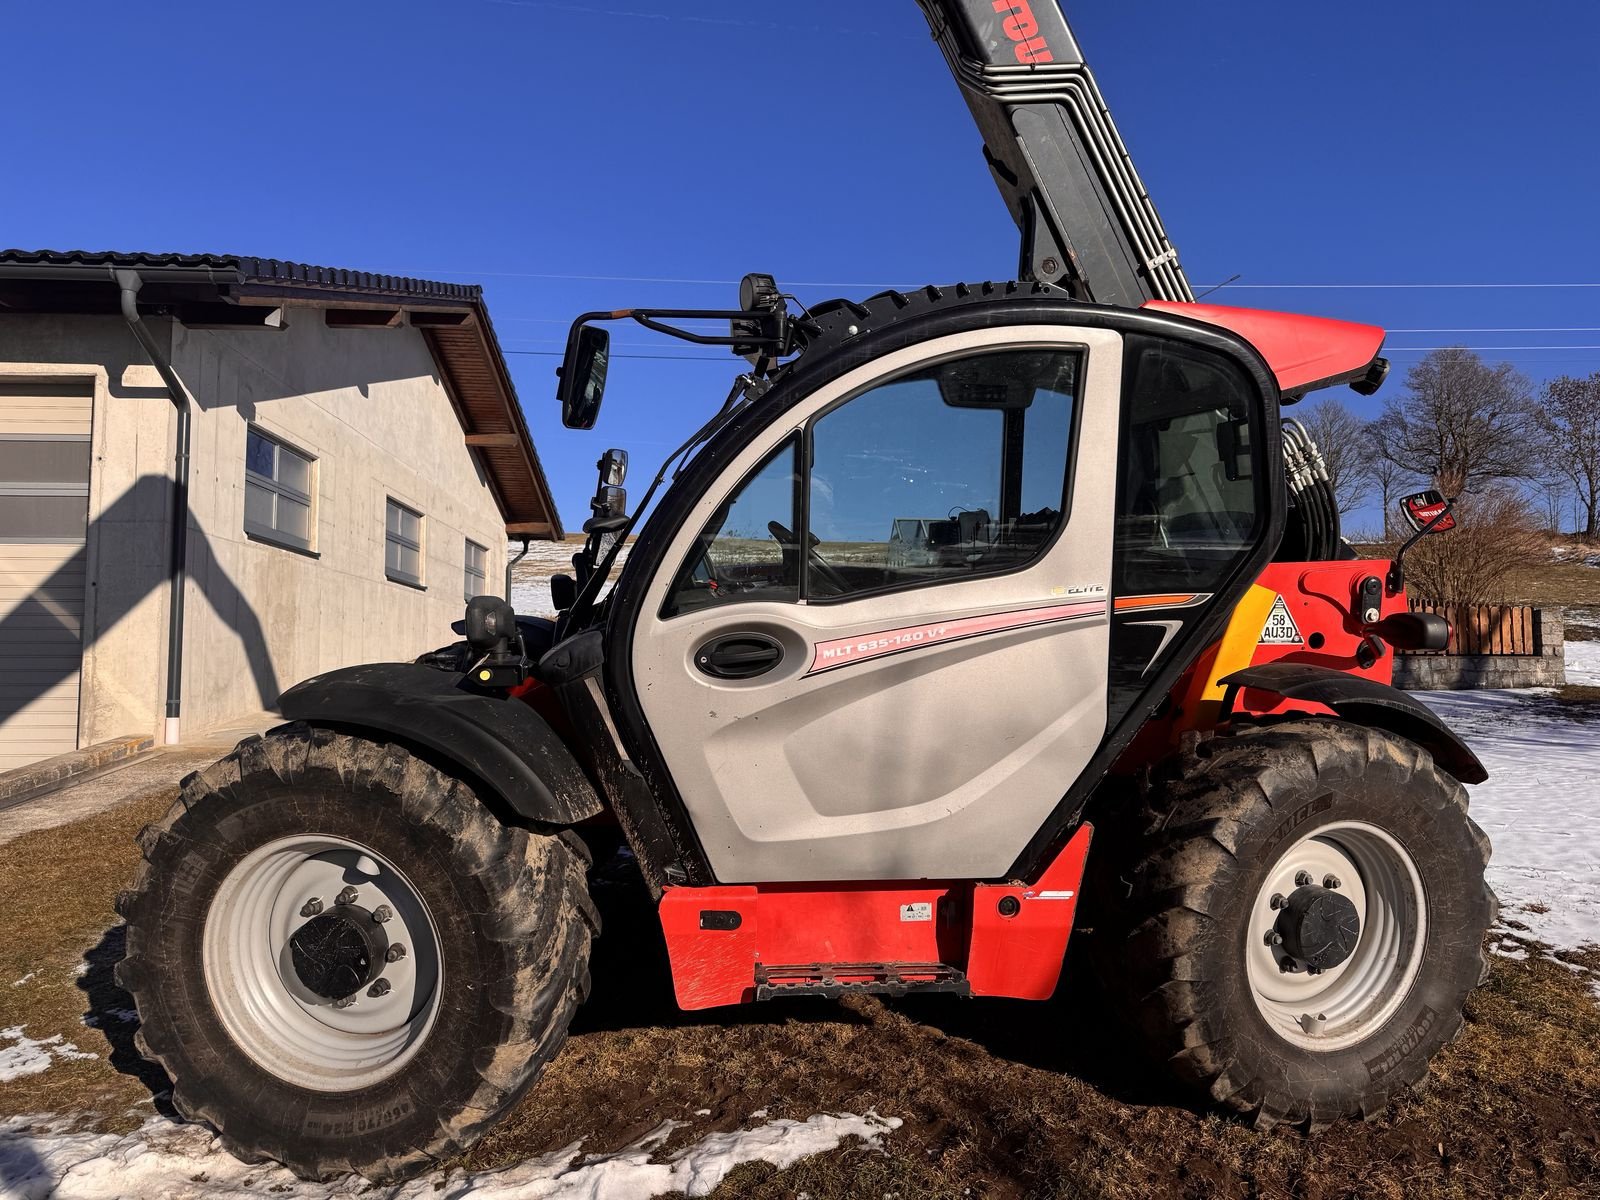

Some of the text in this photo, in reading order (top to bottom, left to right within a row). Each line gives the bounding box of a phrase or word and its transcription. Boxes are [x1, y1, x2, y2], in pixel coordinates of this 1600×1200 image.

[1272, 614, 1286, 626] 58
[1263, 626, 1293, 638] AU3D
[823, 643, 854, 659] MLT
[857, 631, 924, 652] 635-140
